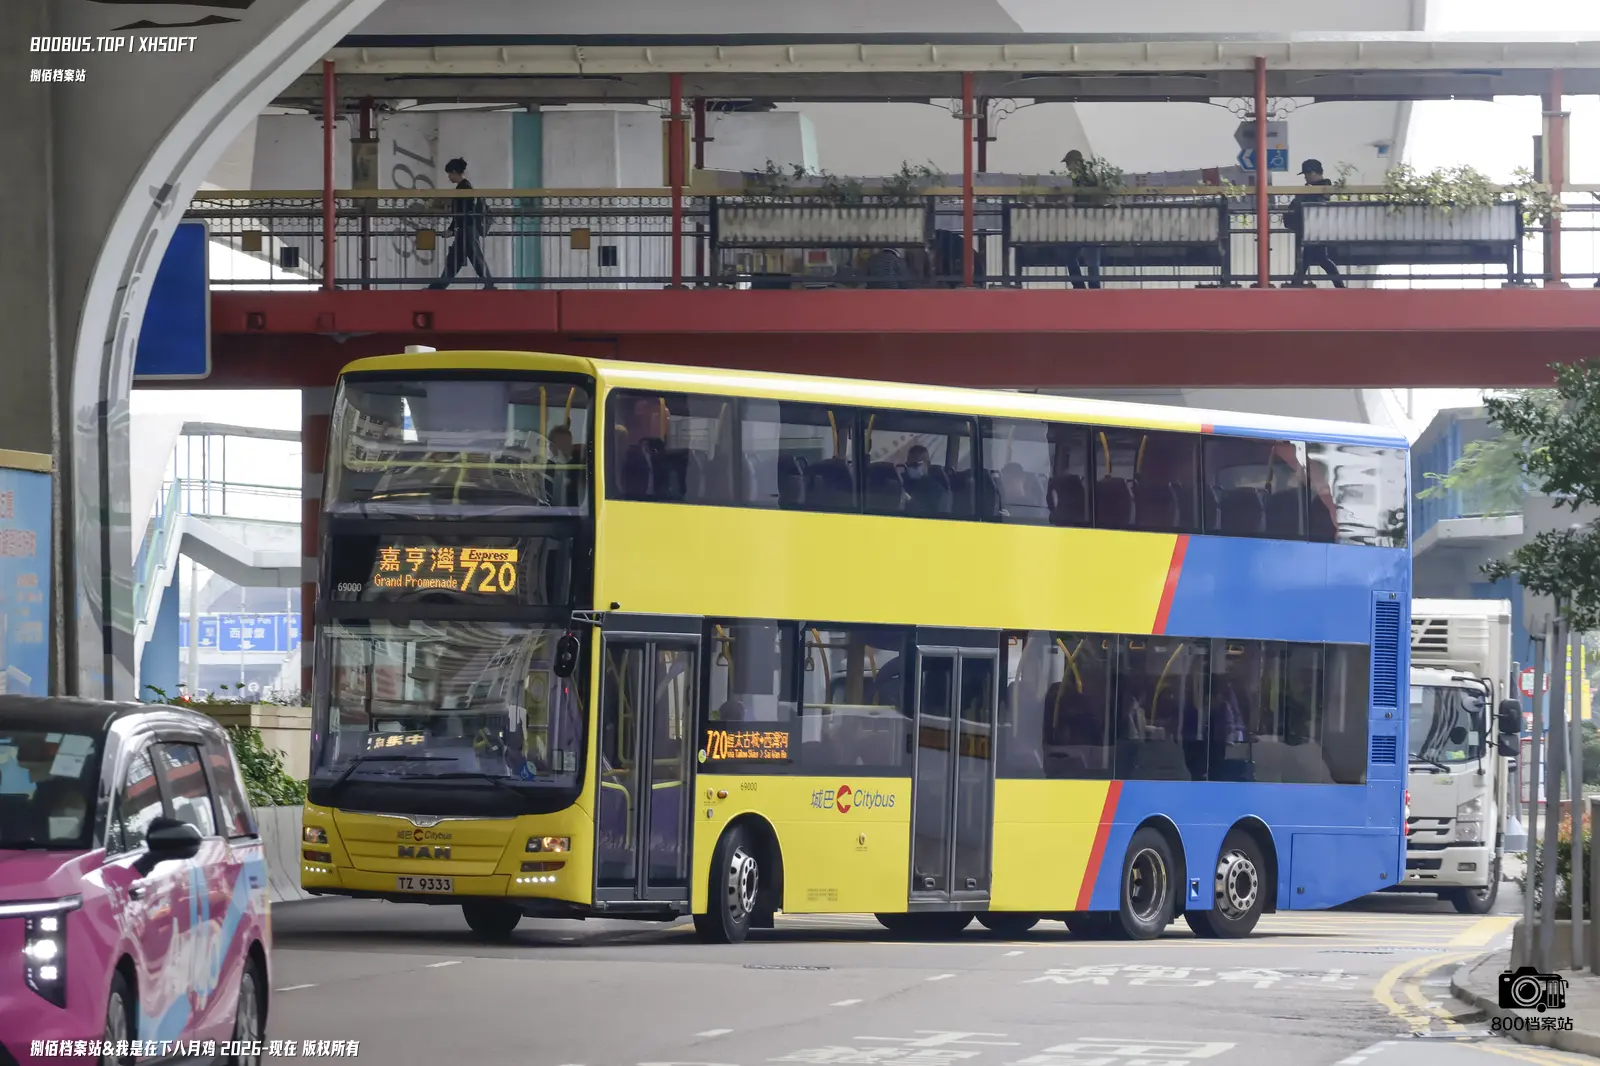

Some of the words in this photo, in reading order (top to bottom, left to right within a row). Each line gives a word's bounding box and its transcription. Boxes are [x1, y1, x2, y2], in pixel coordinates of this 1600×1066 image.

[378, 546, 455, 573] 嘉亨灣
[468, 550, 509, 562] Express
[374, 573, 402, 587] Grand
[405, 574, 458, 589] Promenade
[459, 561, 517, 592] 720
[337, 582, 362, 592] 69000
[706, 730, 728, 760] 720
[740, 782, 758, 791] 69000
[810, 788, 835, 809] 城巴
[853, 789, 895, 809] Citybus
[424, 830, 452, 840] Citybus
[397, 844, 451, 860] MAN
[398, 877, 414, 890] TZ
[419, 878, 451, 891] 9333
